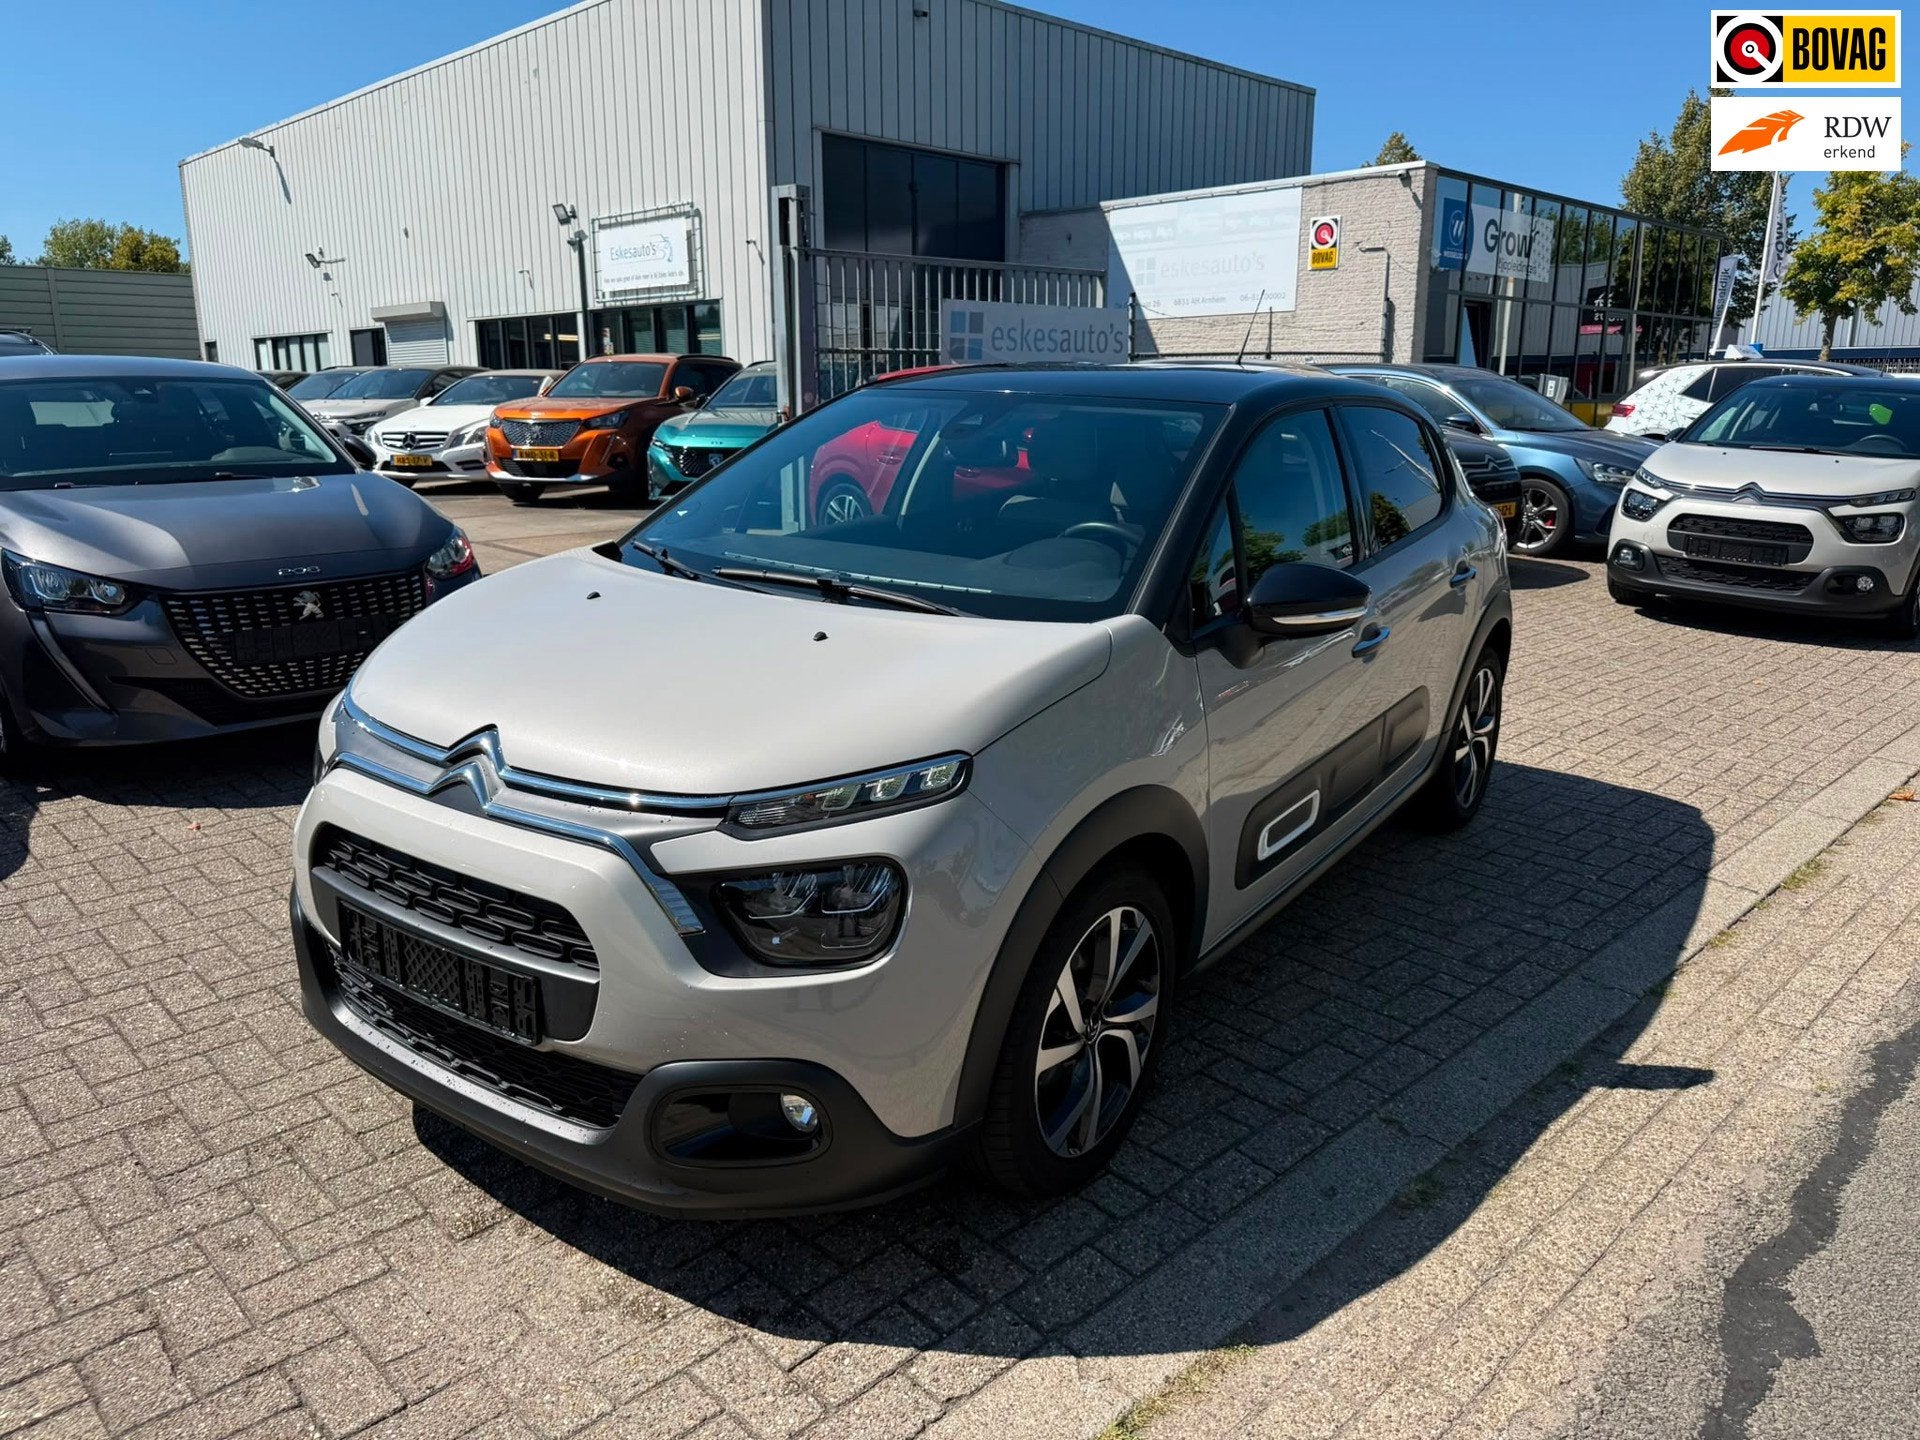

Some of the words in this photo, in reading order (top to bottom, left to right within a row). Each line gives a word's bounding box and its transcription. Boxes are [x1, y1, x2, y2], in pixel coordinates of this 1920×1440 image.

[610, 242, 656, 261] Eskesauto's
[1160, 252, 1265, 278] eskesauto's
[991, 318, 1124, 354] eskesauto's
